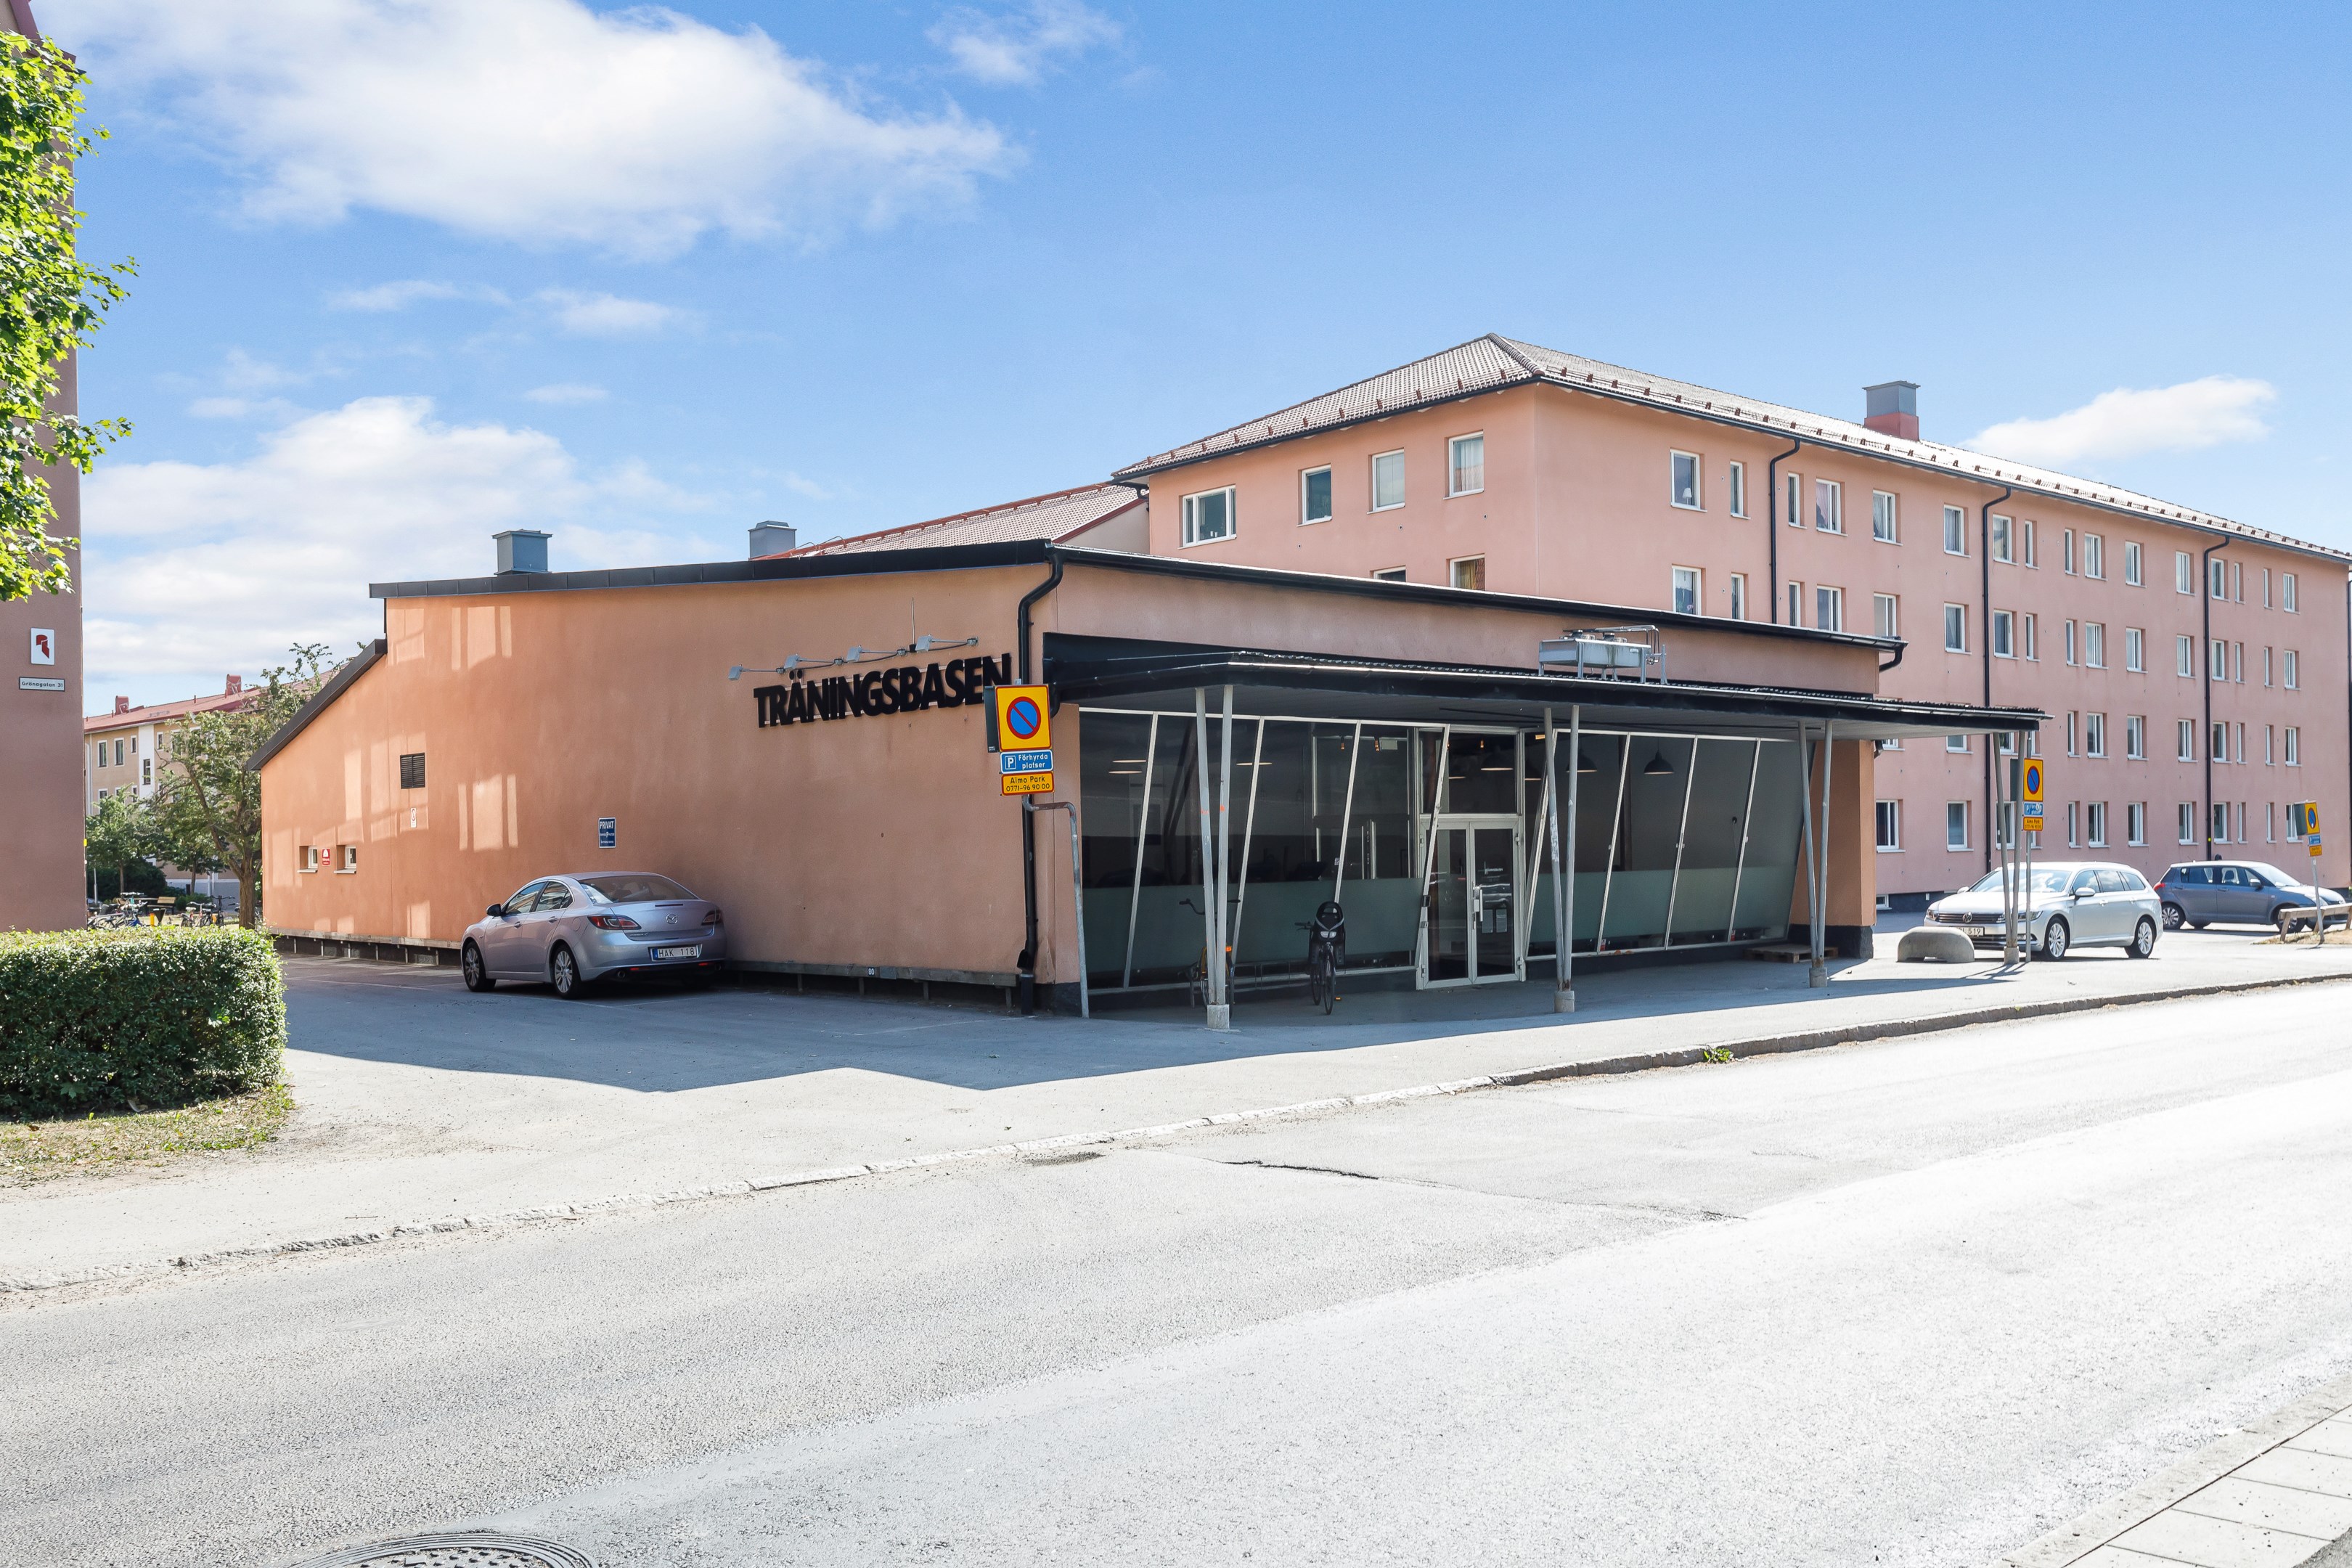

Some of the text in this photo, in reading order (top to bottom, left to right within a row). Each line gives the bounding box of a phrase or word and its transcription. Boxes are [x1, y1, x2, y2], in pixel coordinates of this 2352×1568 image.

[754, 653, 1010, 728] TRÄNINGSBASEN
[600, 820, 614, 829] PRIVAT
[658, 947, 695, 957] HAK 118
